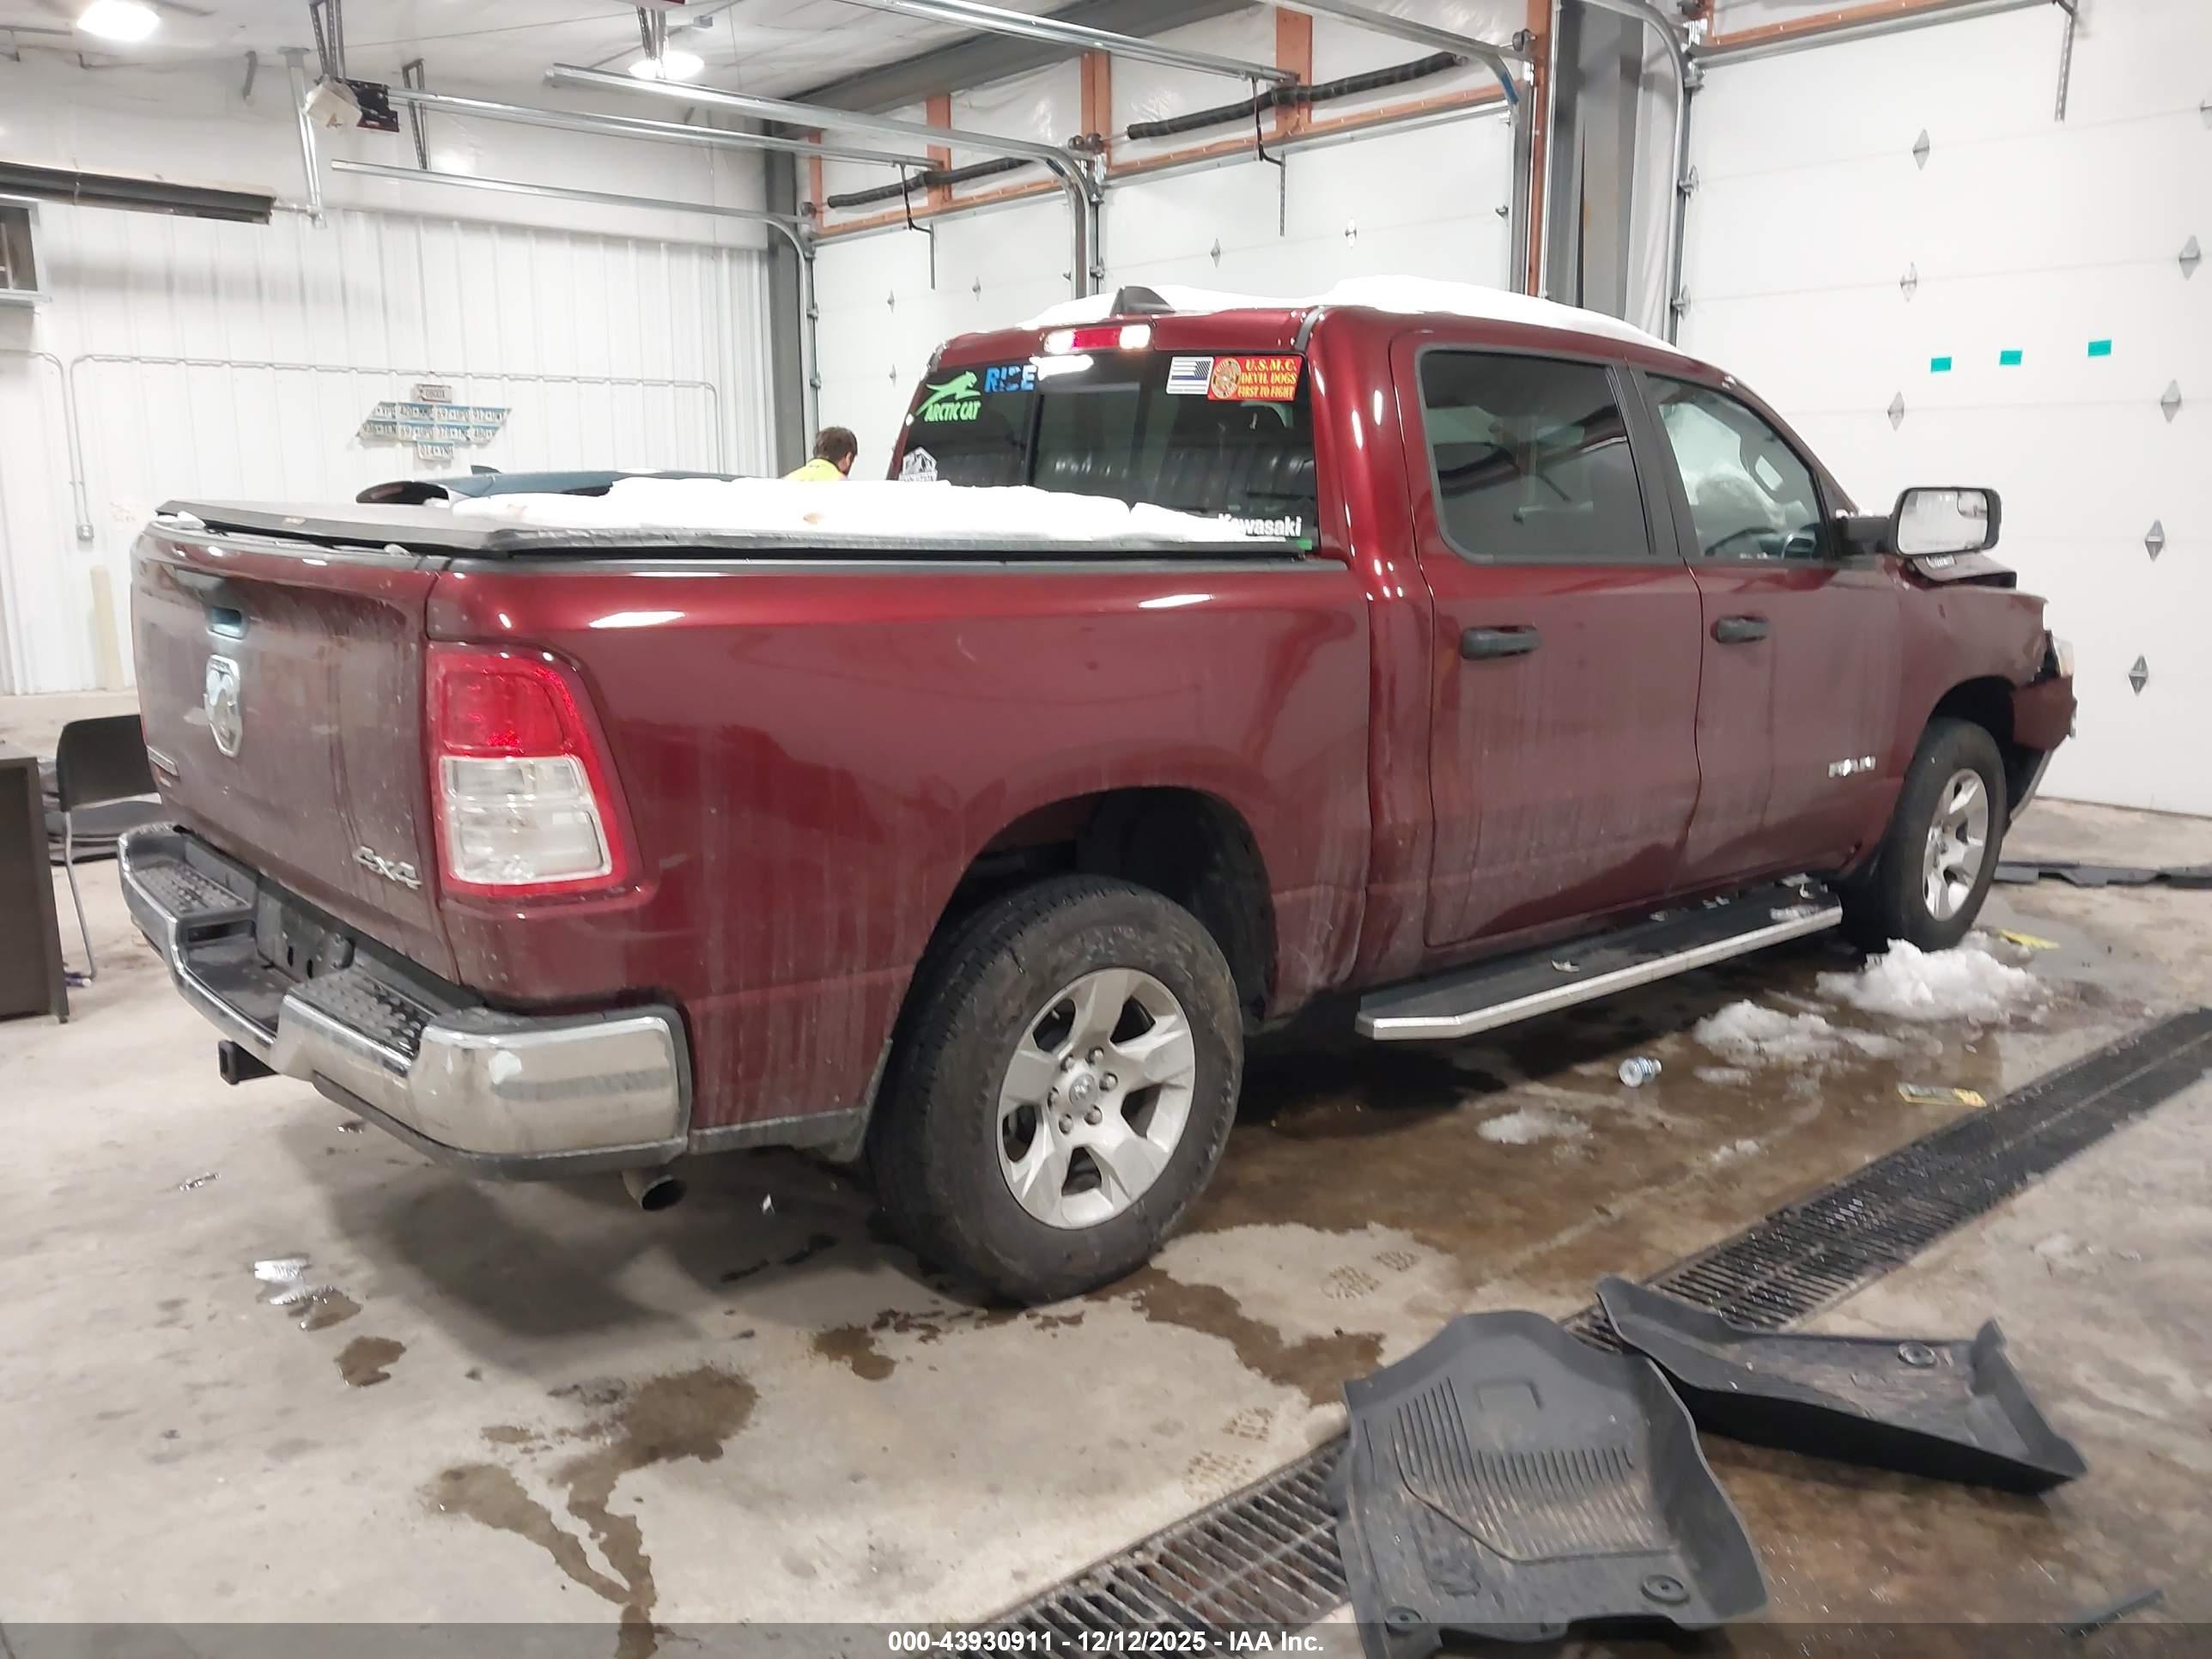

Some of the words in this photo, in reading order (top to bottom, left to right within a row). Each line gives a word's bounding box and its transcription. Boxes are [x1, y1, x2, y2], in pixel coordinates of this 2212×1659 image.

[1245, 358, 1297, 371] U.S.M.C.
[1241, 372, 1267, 384] DEVIL
[1270, 372, 1297, 384] DOGS
[1237, 385, 1259, 398] FIRST
[1260, 385, 1270, 398] TO
[1271, 385, 1294, 398] FIGHT
[924, 402, 960, 422] ARCTIC
[960, 400, 981, 421] CAT
[1218, 513, 1303, 537] wasaki
